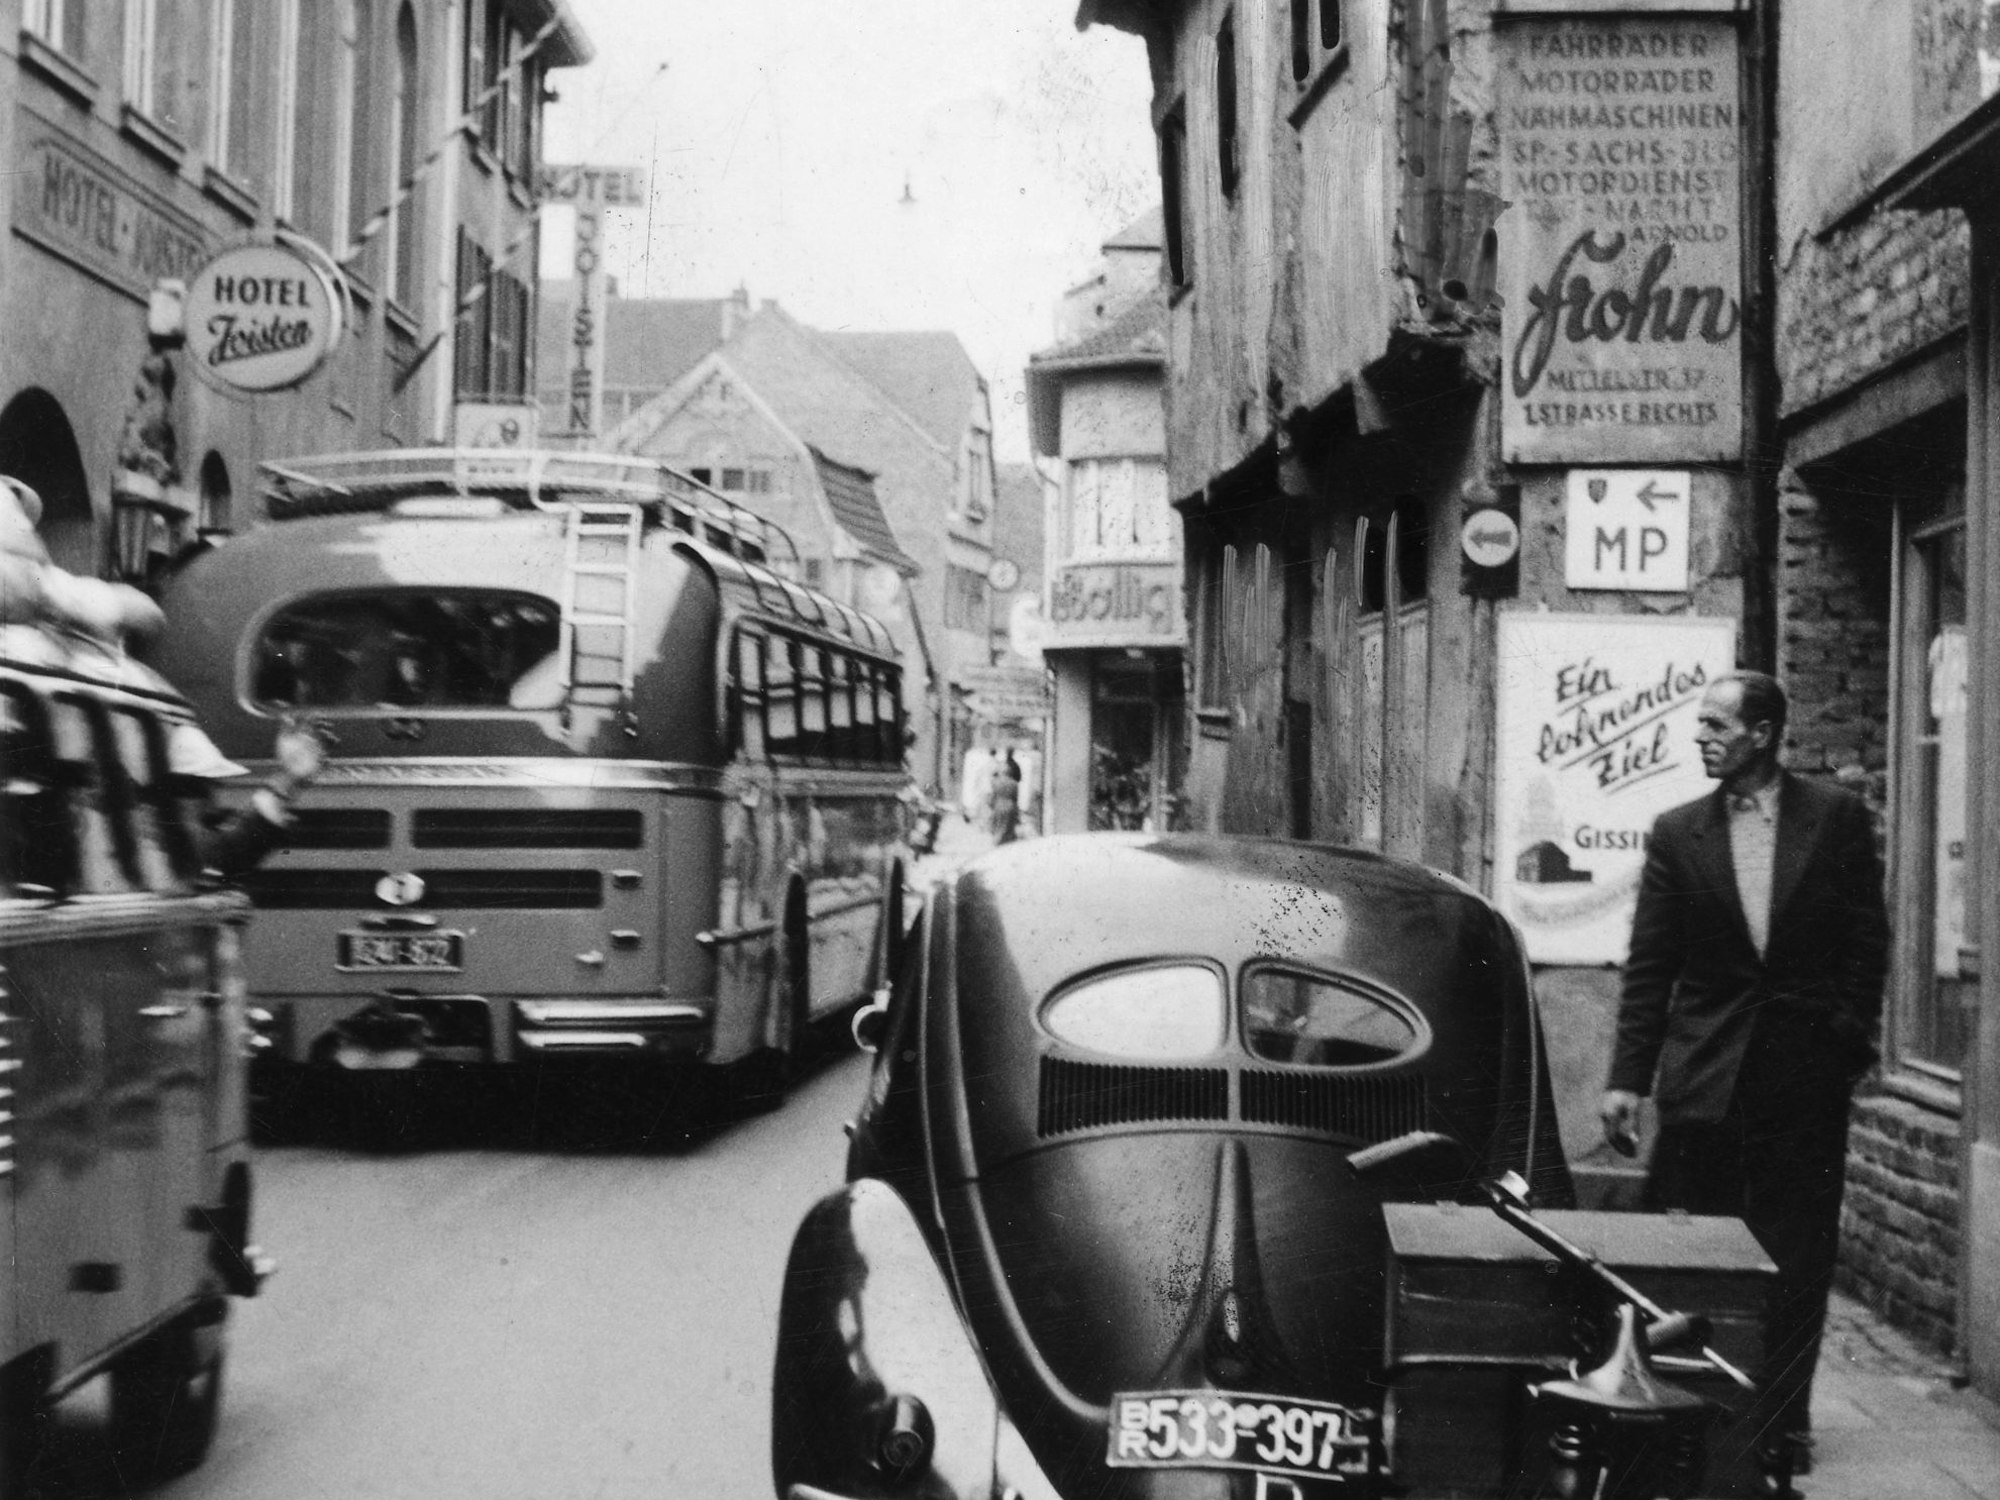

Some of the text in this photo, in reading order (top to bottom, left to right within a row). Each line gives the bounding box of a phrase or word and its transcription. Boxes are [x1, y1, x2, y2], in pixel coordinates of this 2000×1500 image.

[214, 276, 311, 308] HOTEL
[1594, 526, 1669, 573] MP
[1556, 657, 1615, 702] Ein
[1588, 722, 1669, 788] Ziel
[1574, 825, 1652, 851] GISSI
